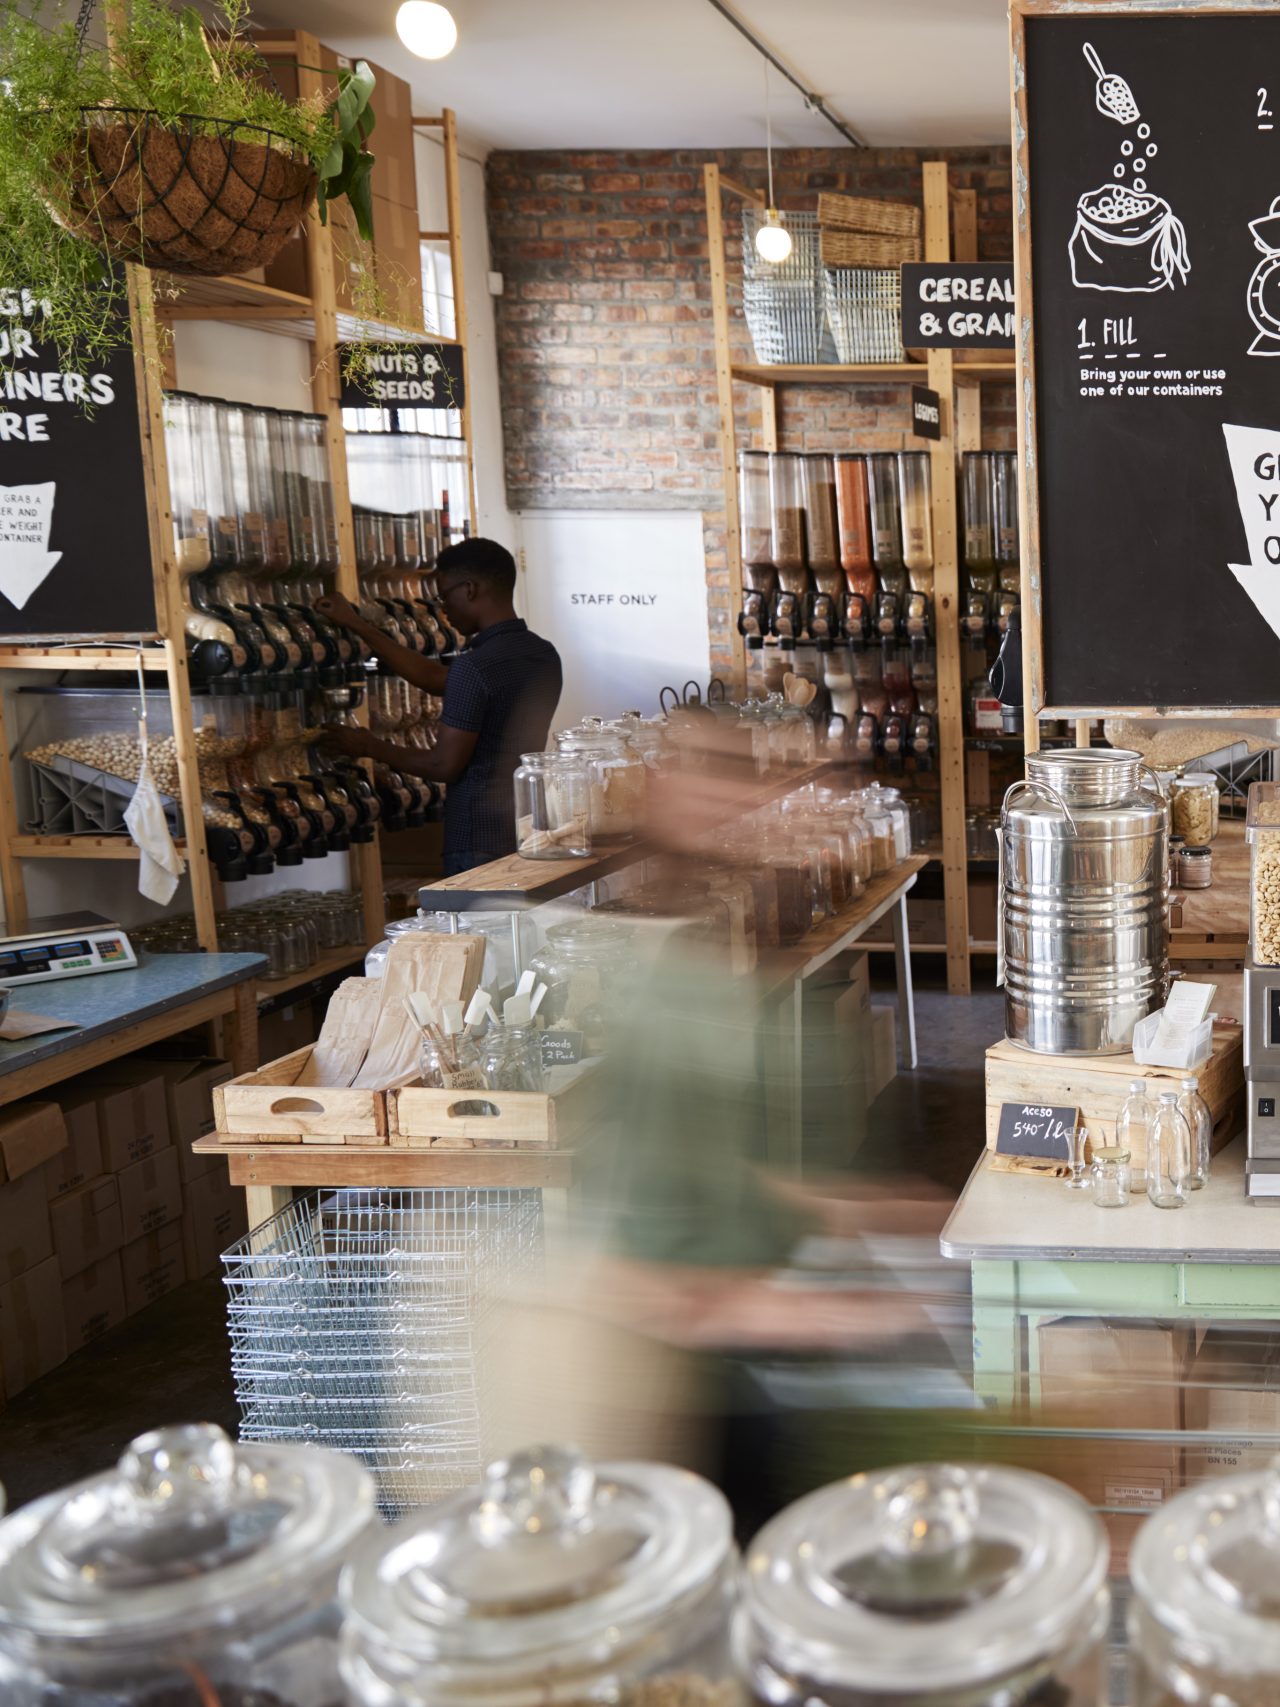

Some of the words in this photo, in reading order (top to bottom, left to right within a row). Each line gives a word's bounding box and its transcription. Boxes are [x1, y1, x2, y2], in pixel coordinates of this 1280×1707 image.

[1257, 87, 1273, 117] 2.
[919, 312, 943, 337] &
[948, 312, 1016, 338] GRAI
[1077, 318, 1096, 349] 1.
[1103, 316, 1138, 346] FILL
[365, 353, 419, 375] NUTS
[422, 353, 441, 375] &
[1080, 367, 1117, 383] Bring
[1119, 369, 1151, 383] your
[1153, 370, 1182, 380] own
[1185, 370, 1200, 380] or
[1203, 369, 1226, 380] use
[373, 380, 436, 401] SEEDS
[1080, 386, 1105, 397] one
[1109, 384, 1124, 396] of
[1127, 386, 1150, 396] our
[1153, 384, 1223, 396] containers
[18, 508, 38, 517] AND
[9, 521, 43, 532] WEIGHT
[570, 593, 614, 605] STAFF
[619, 594, 658, 606] ONLY
